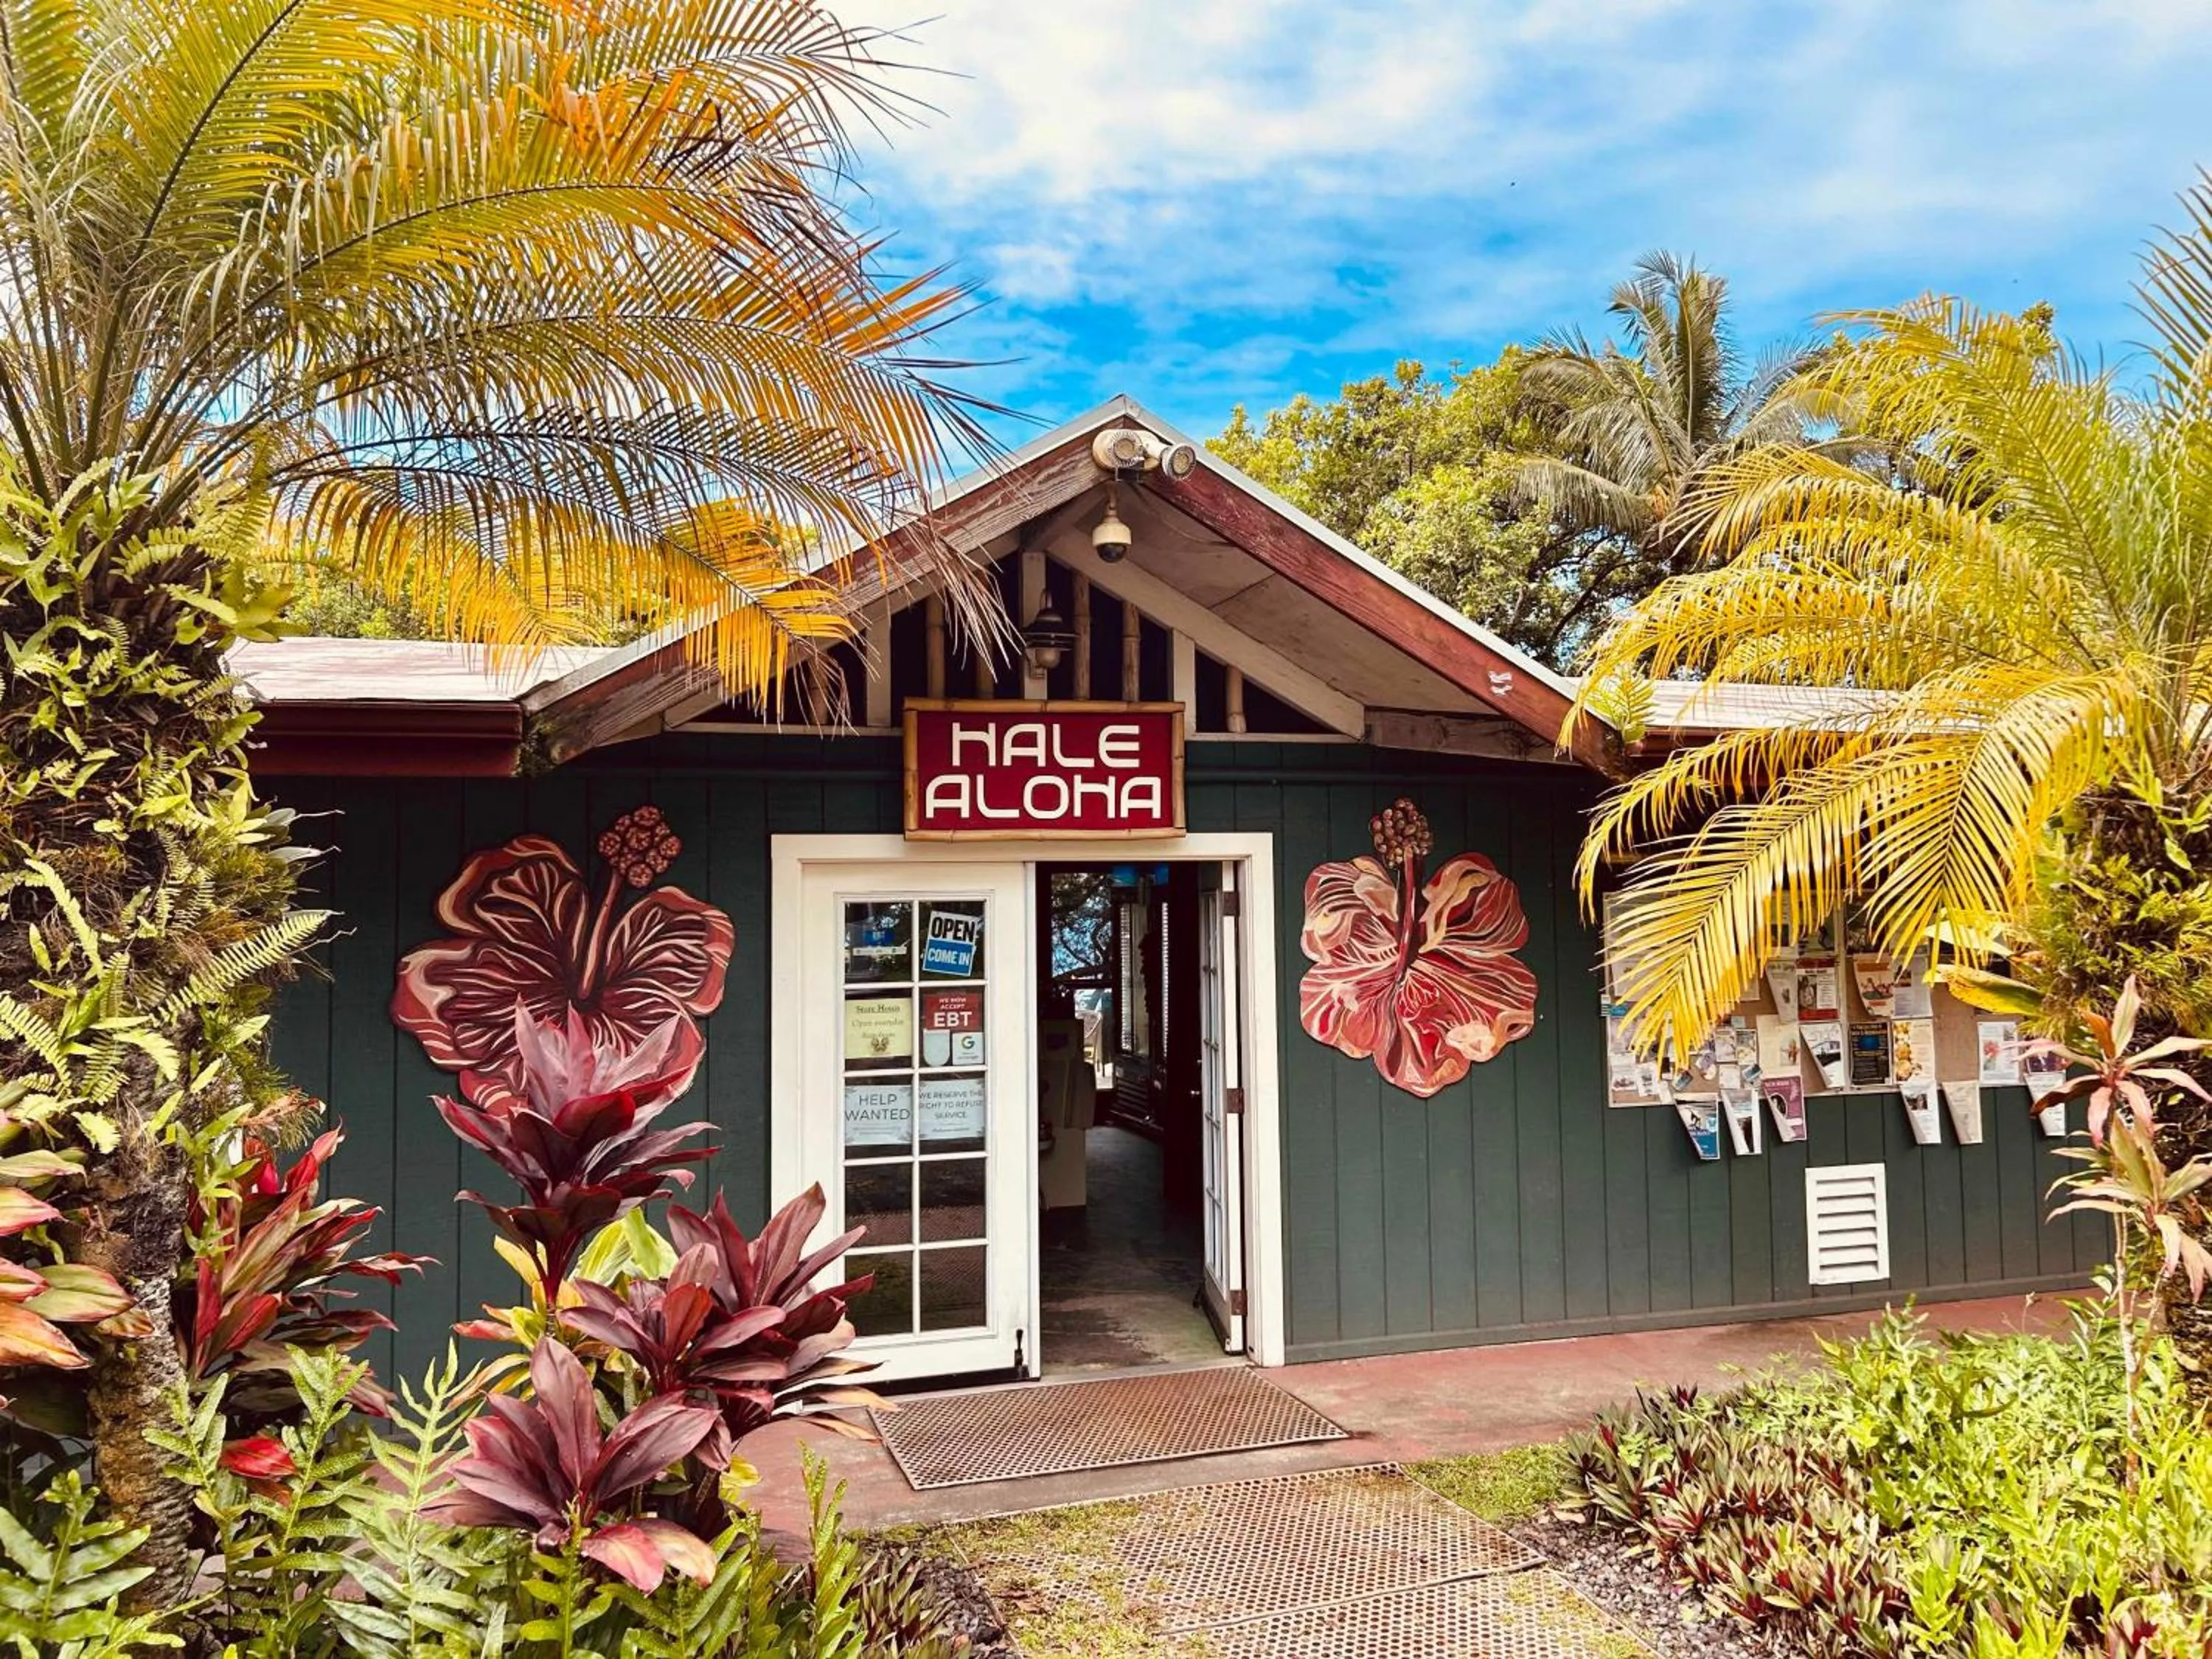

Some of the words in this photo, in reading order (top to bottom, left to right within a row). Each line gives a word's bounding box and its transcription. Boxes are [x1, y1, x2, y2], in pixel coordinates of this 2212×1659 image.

[952, 722, 1140, 768] HALE
[925, 774, 1161, 819] ALOHA
[931, 917, 975, 942] OPEN
[928, 947, 957, 964] COME
[958, 952, 970, 966] IN
[933, 1011, 973, 1027] EBT
[859, 1093, 897, 1106] HELP
[845, 1108, 911, 1121] WANTED
